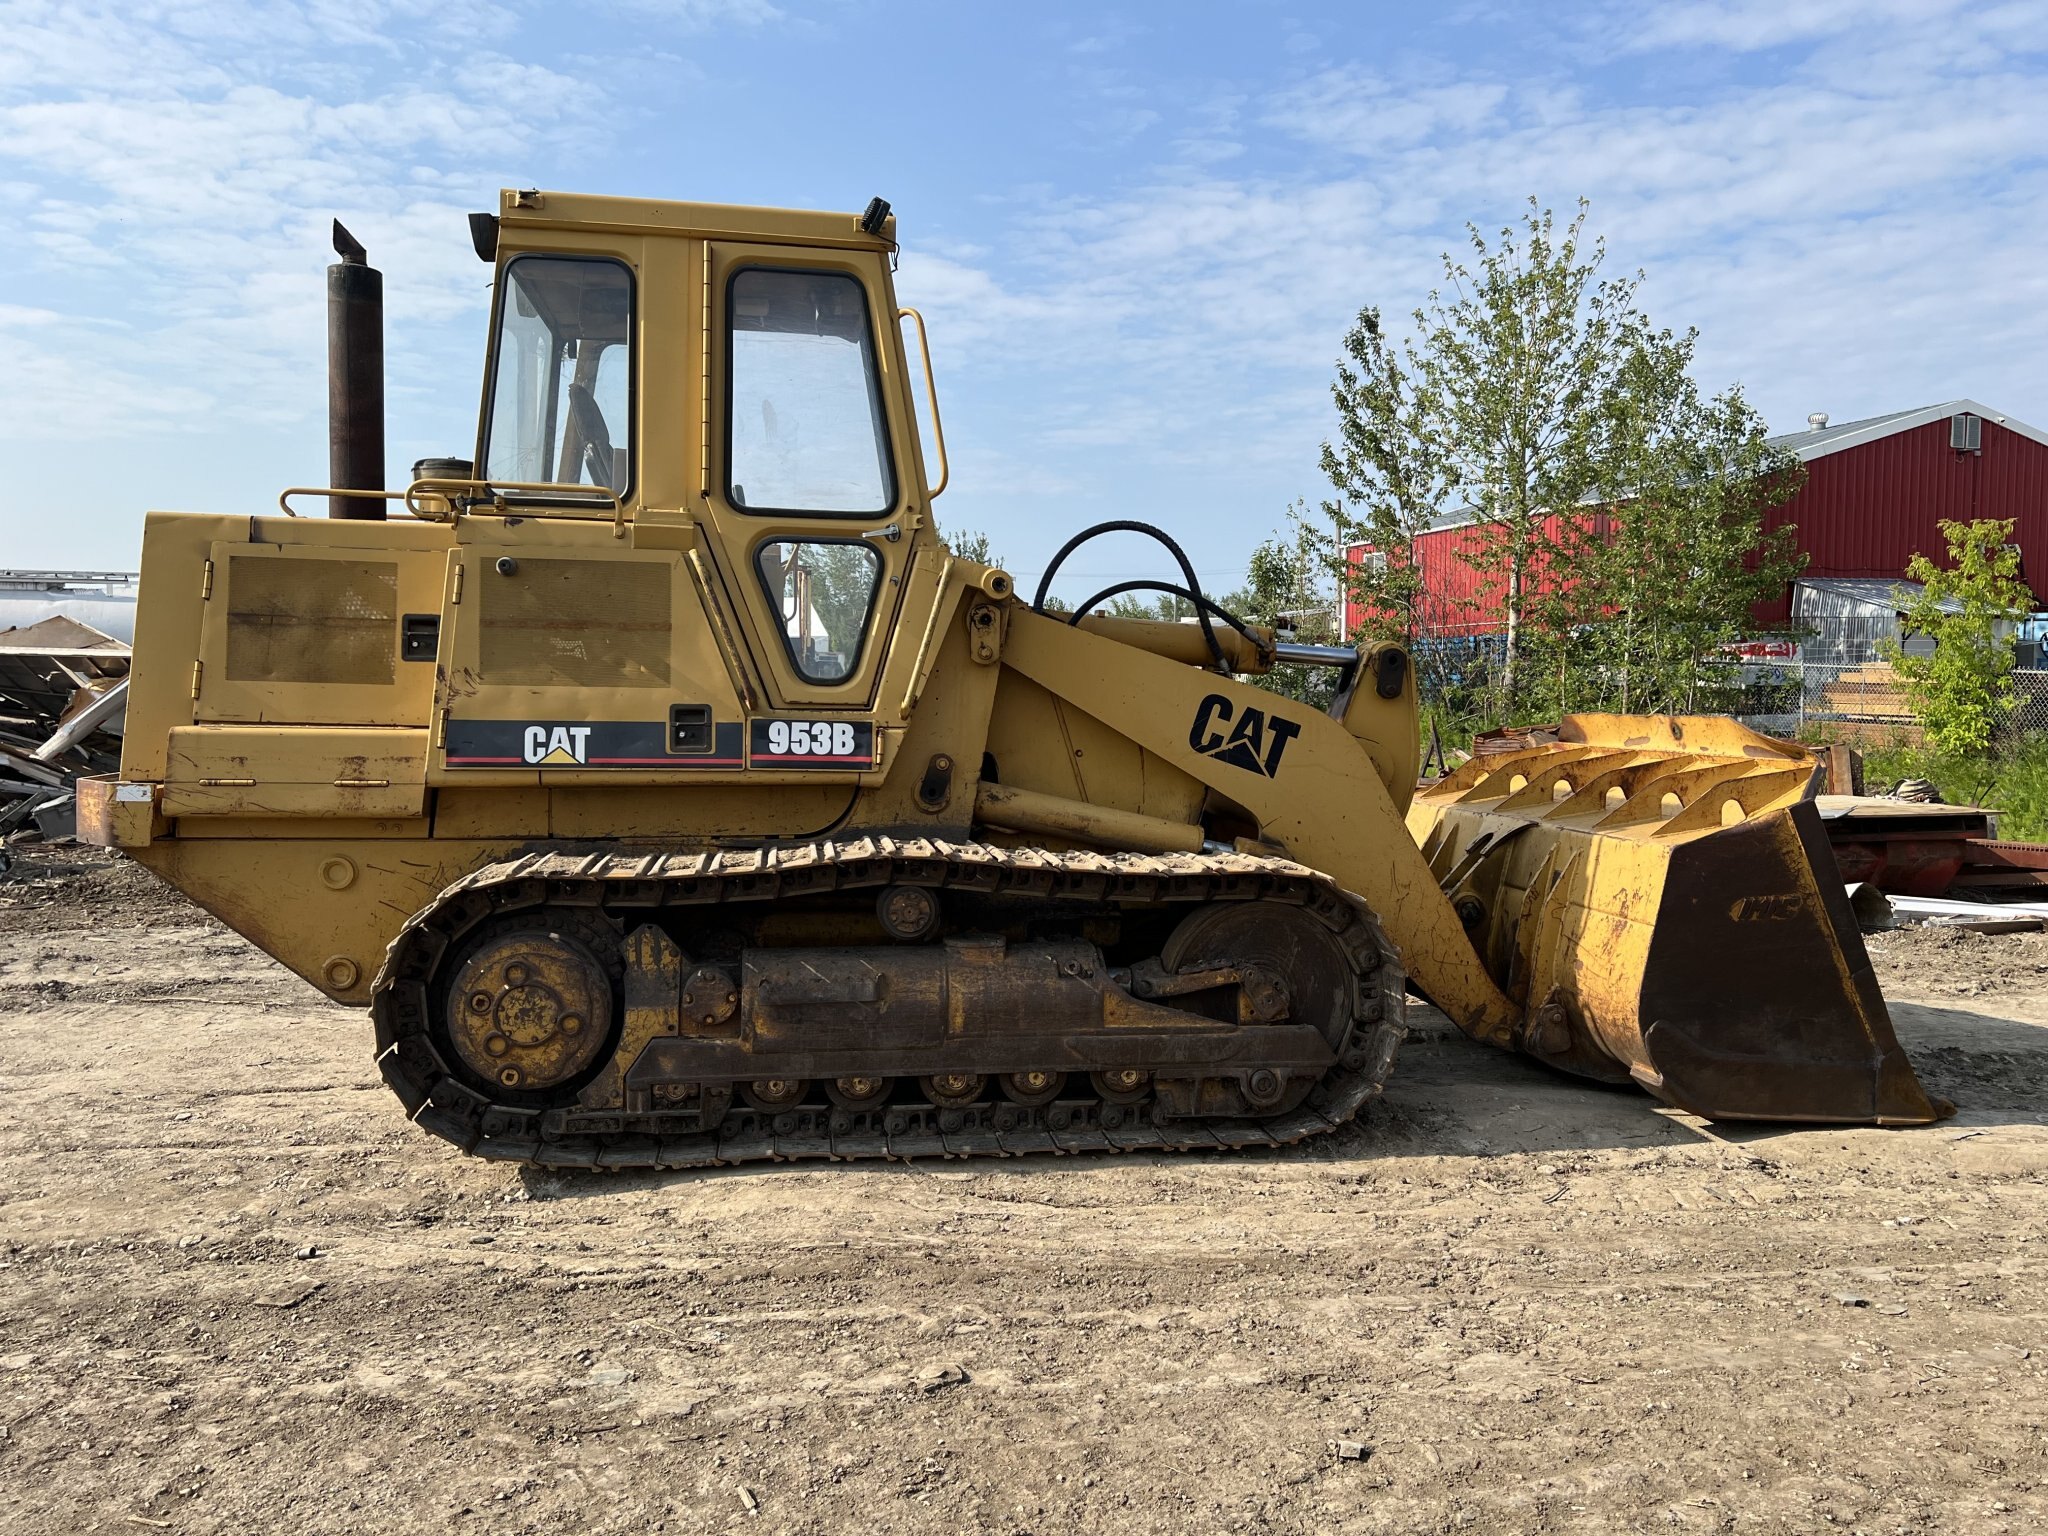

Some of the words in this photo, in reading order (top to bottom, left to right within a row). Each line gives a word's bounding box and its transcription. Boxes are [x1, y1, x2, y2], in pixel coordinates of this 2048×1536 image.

[523, 725, 591, 764] CAT
[768, 720, 855, 755] 953B
[1189, 693, 1302, 779] CAT
